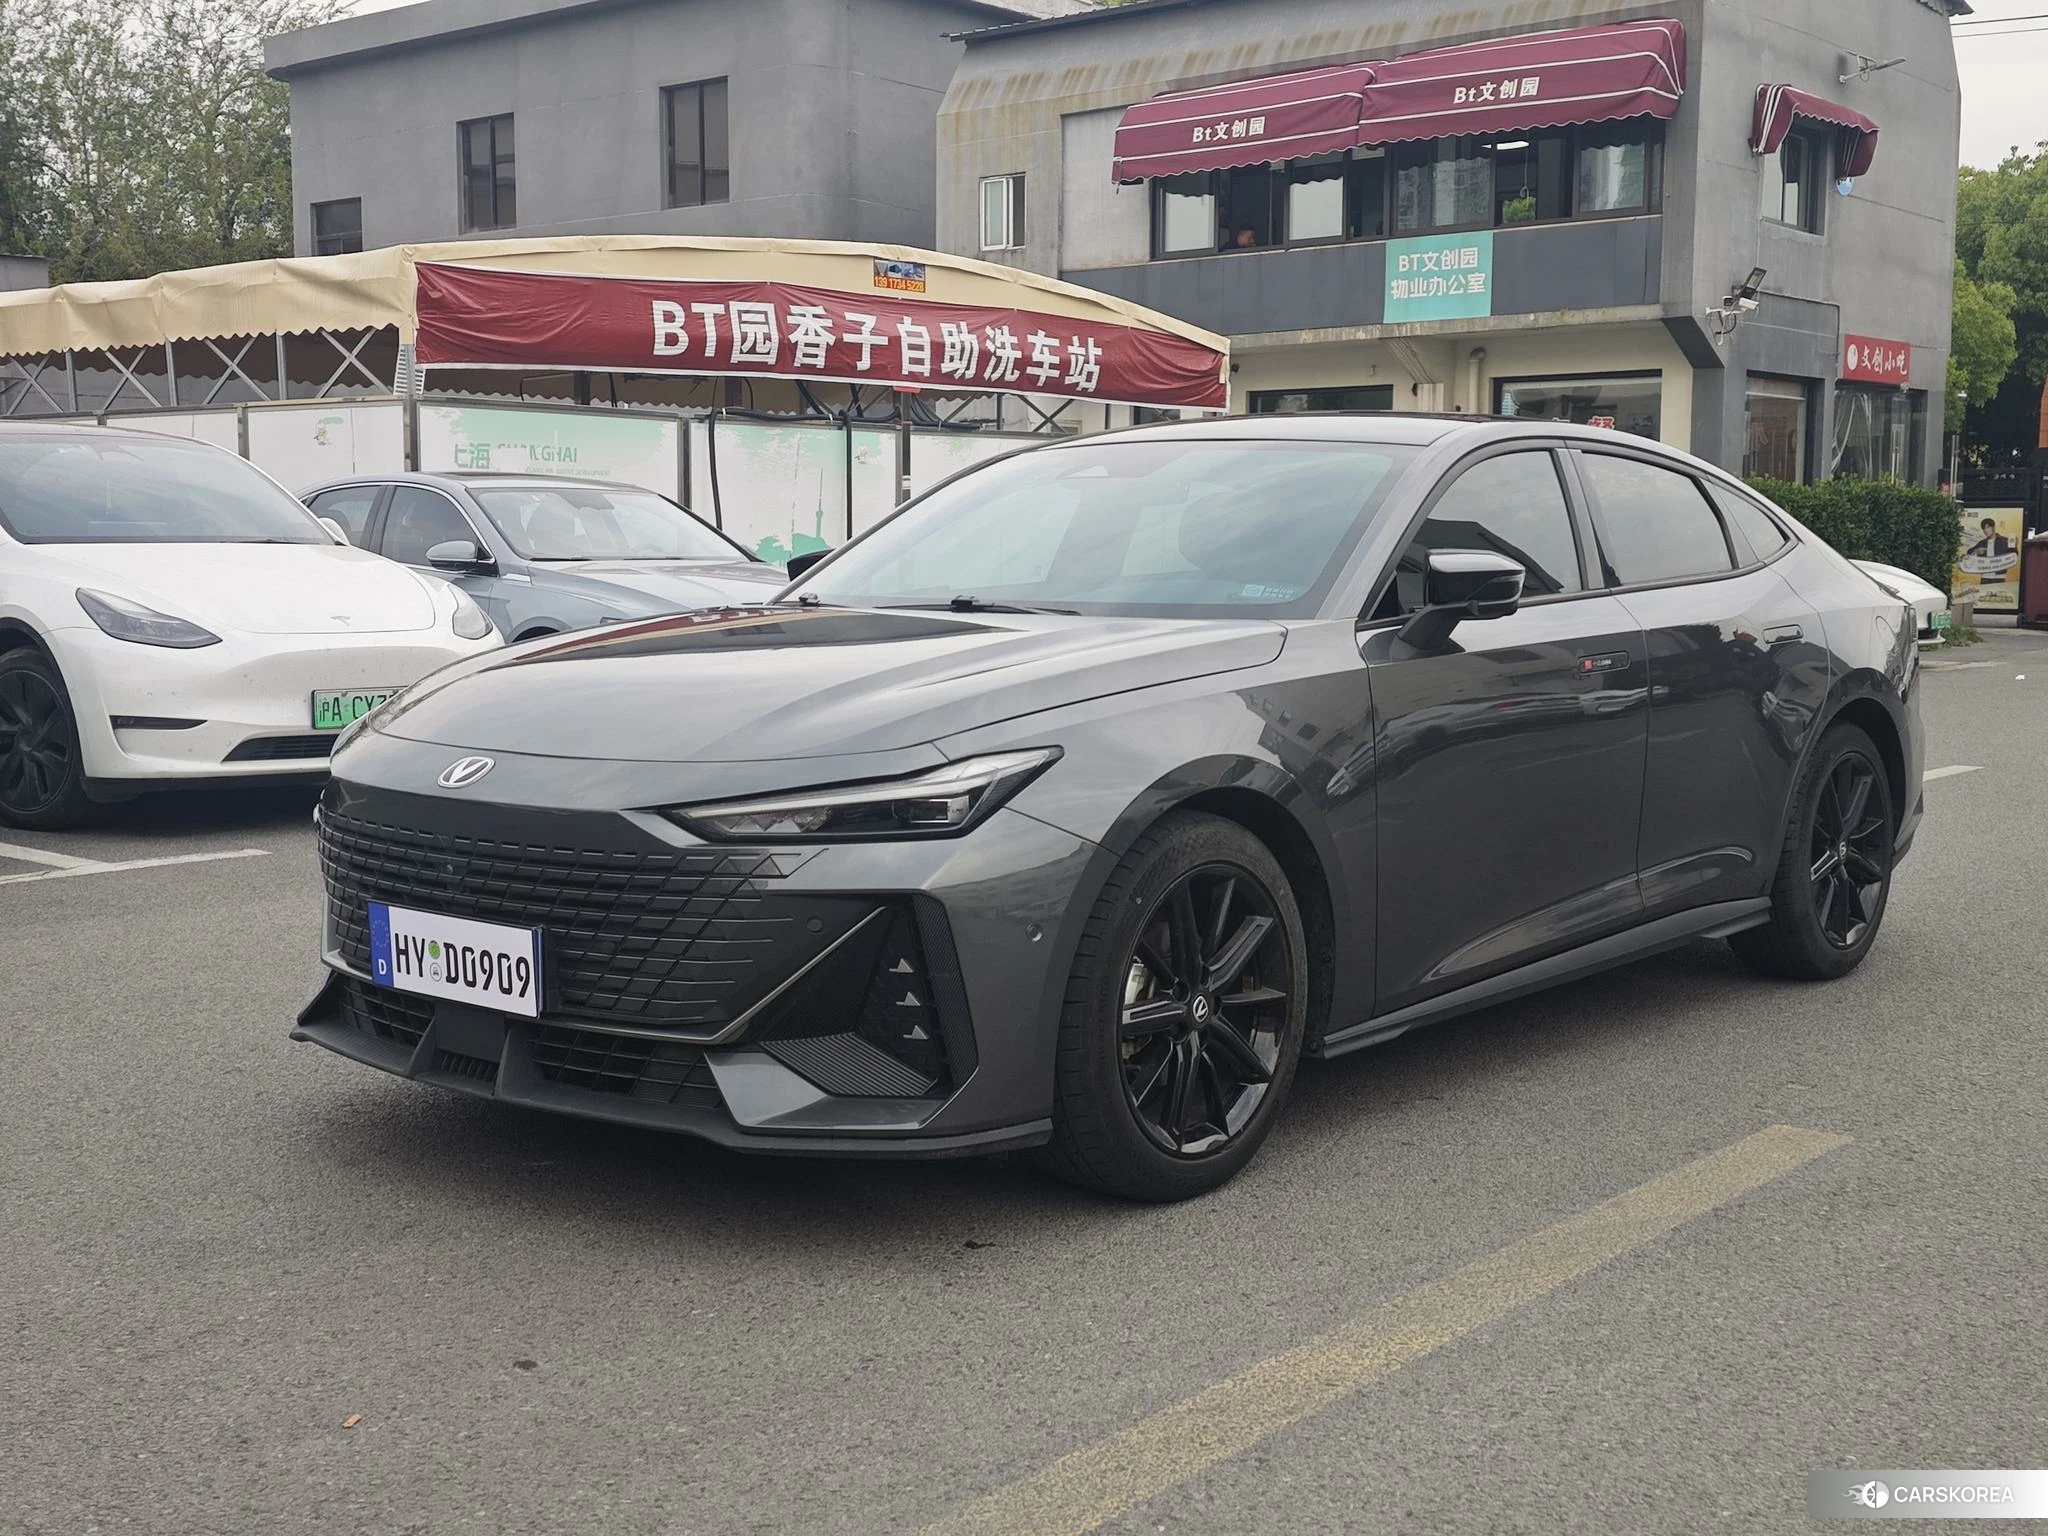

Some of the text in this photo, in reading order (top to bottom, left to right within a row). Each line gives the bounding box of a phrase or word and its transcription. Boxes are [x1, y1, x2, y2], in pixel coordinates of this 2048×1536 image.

[1453, 76, 1541, 104] Bt文创园
[1191, 115, 1266, 143] Bt文创园
[1398, 247, 1479, 273] BT文创园
[1391, 272, 1486, 300] 物业办公室
[651, 299, 1104, 393] BT园香子自助洗车站
[497, 443, 577, 463] NGHAI
[378, 958, 387, 975] D
[394, 932, 531, 998] HY D0909
